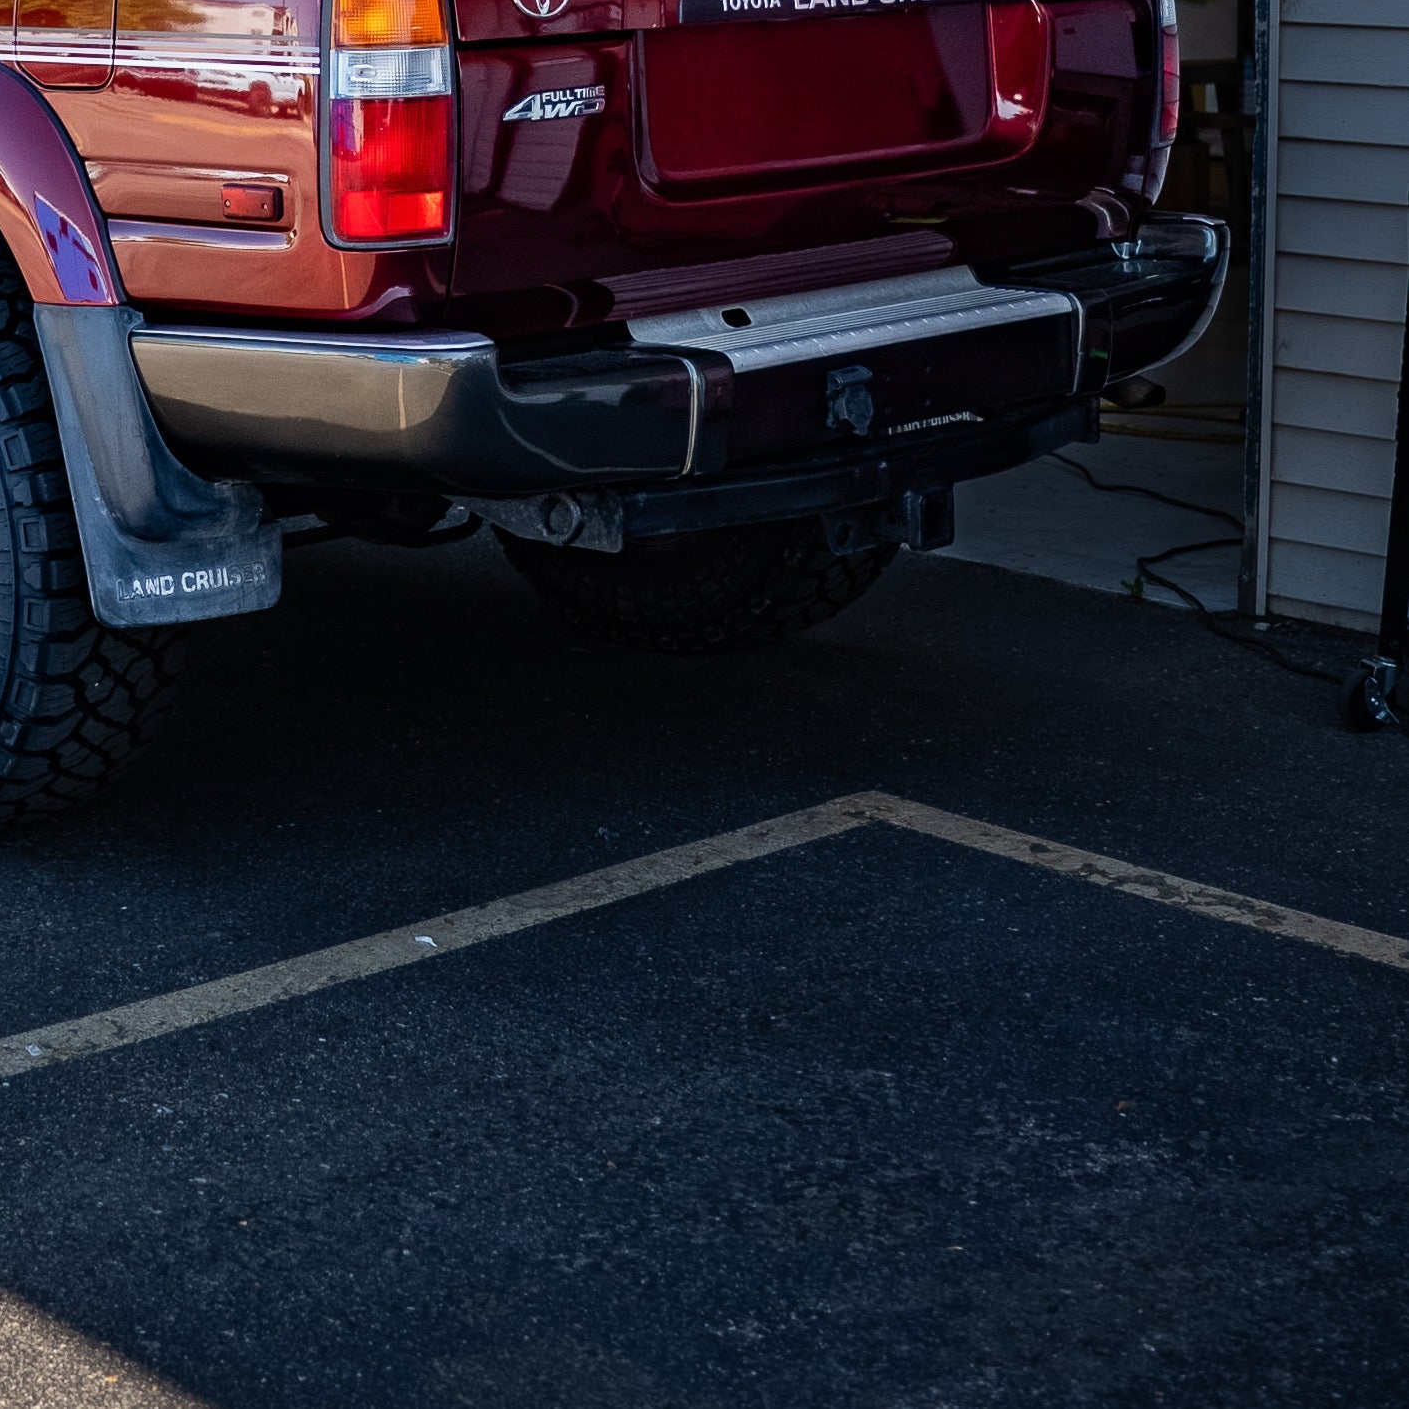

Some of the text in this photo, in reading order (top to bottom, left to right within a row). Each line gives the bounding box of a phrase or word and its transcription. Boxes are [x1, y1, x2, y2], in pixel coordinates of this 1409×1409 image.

[502, 93, 606, 122] 4WD
[542, 89, 574, 103] FULL
[116, 561, 267, 602] LAND CRUISER
